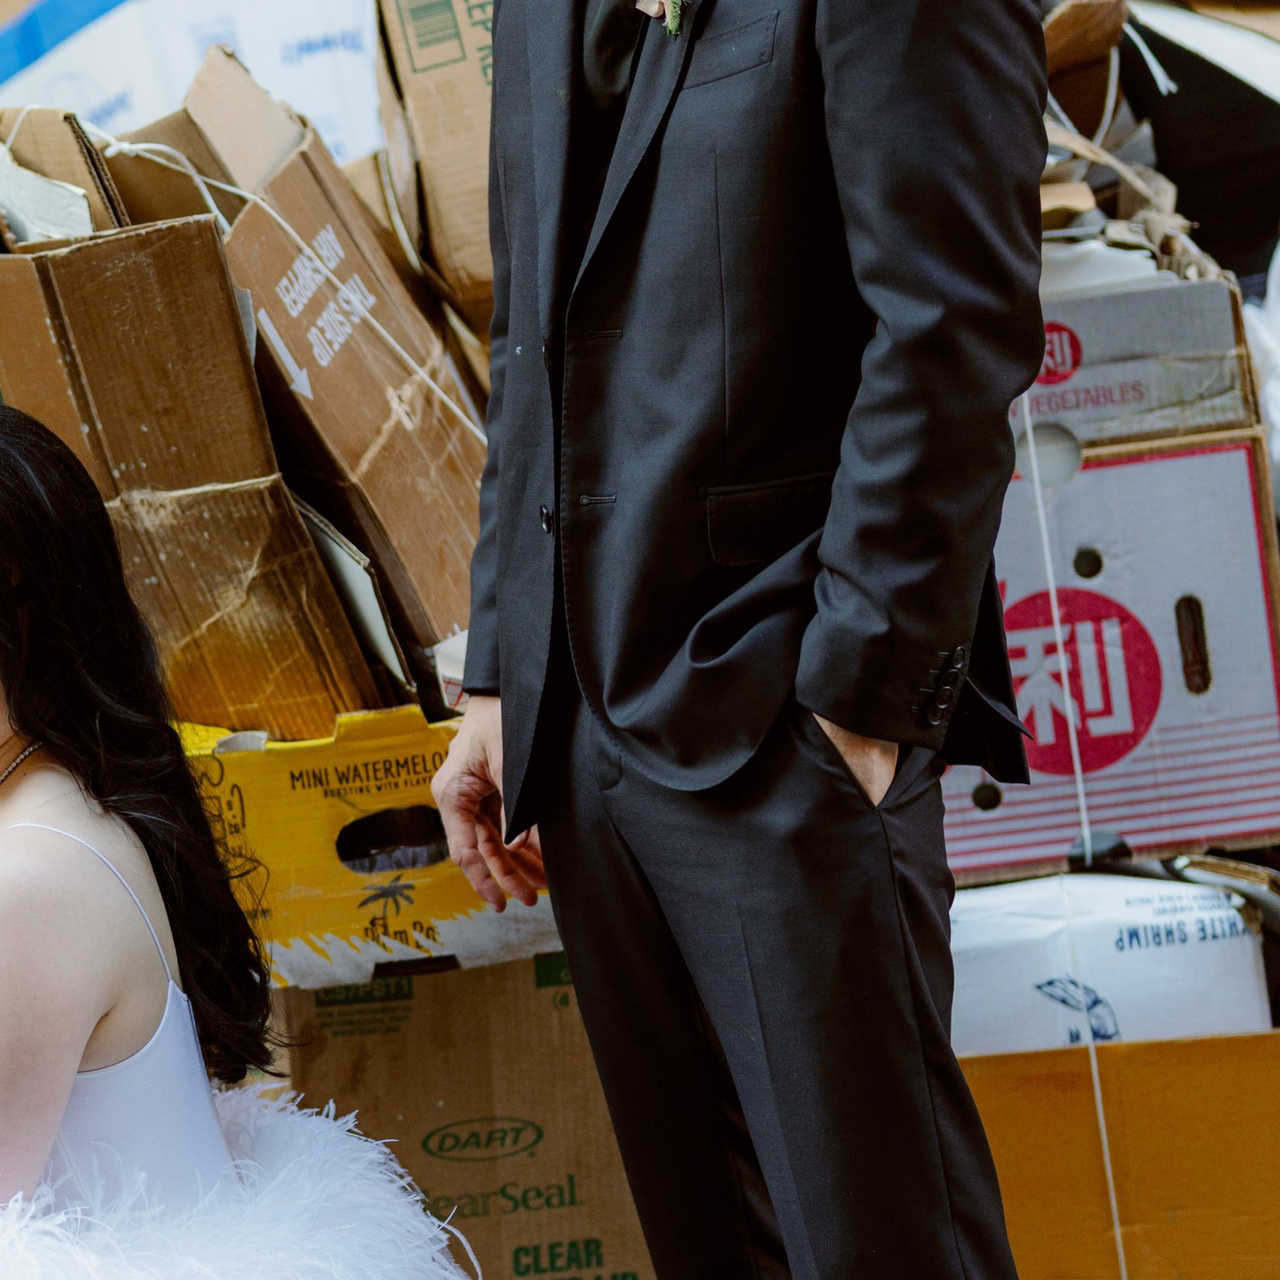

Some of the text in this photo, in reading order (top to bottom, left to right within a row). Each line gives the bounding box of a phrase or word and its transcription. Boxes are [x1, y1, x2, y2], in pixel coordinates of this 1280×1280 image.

[275, 224, 346, 318] AIR SHIPPER
[306, 273, 377, 368] THIS SIDE UP
[290, 751, 448, 791] MINI WATERMELO
[324, 785, 371, 799] BURSTING
[376, 780, 400, 793] WITH
[1115, 920, 1188, 950] SHRIMP
[436, 1126, 528, 1154] DART
[422, 1173, 583, 1219] earSeal
[512, 1237, 604, 1277] CLEAR
